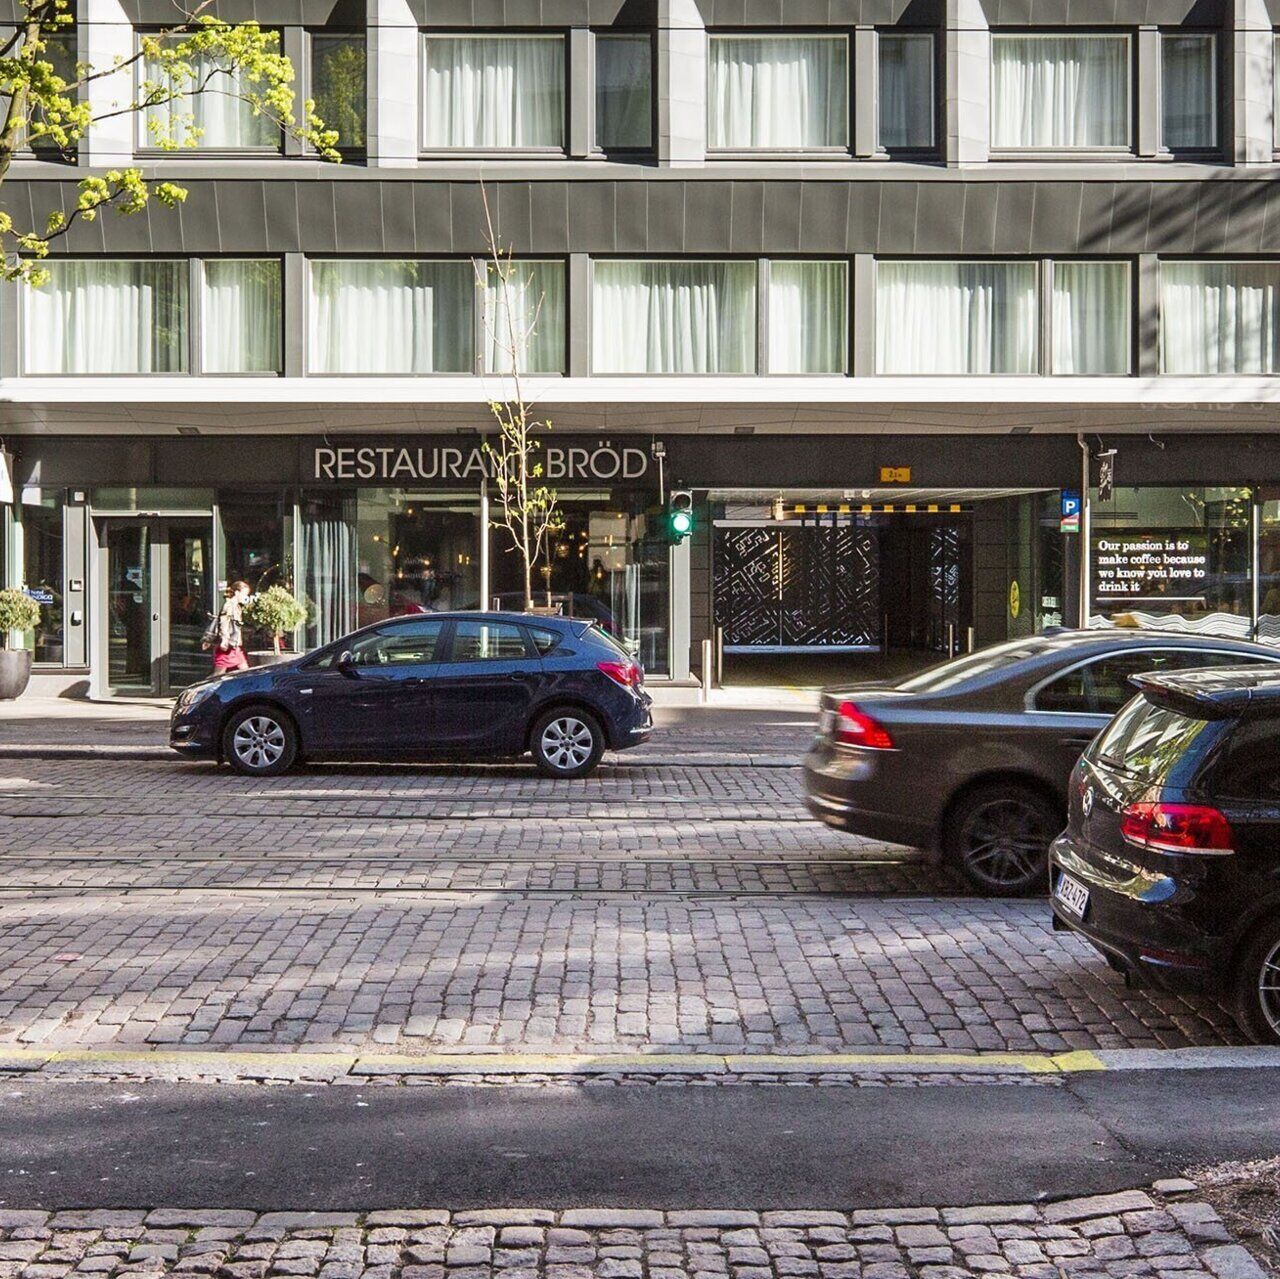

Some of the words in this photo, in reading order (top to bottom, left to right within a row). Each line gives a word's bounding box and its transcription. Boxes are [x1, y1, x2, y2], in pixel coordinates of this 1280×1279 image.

[546, 440, 647, 478] BRÖD
[1065, 500, 1076, 513] P
[1098, 540, 1120, 551] Our
[1122, 540, 1162, 552] passion
[1165, 540, 1175, 550] is
[1177, 540, 1188, 550] to
[1098, 554, 1128, 564] make
[1130, 554, 1161, 564] coffee
[1163, 554, 1206, 564] because
[1098, 570, 1114, 578] we
[1116, 568, 1145, 578] know
[1147, 569, 1167, 579] you
[1169, 567, 1192, 578] love
[1193, 568, 1205, 578] to
[1098, 581, 1128, 591] drink
[1130, 581, 1140, 591] it
